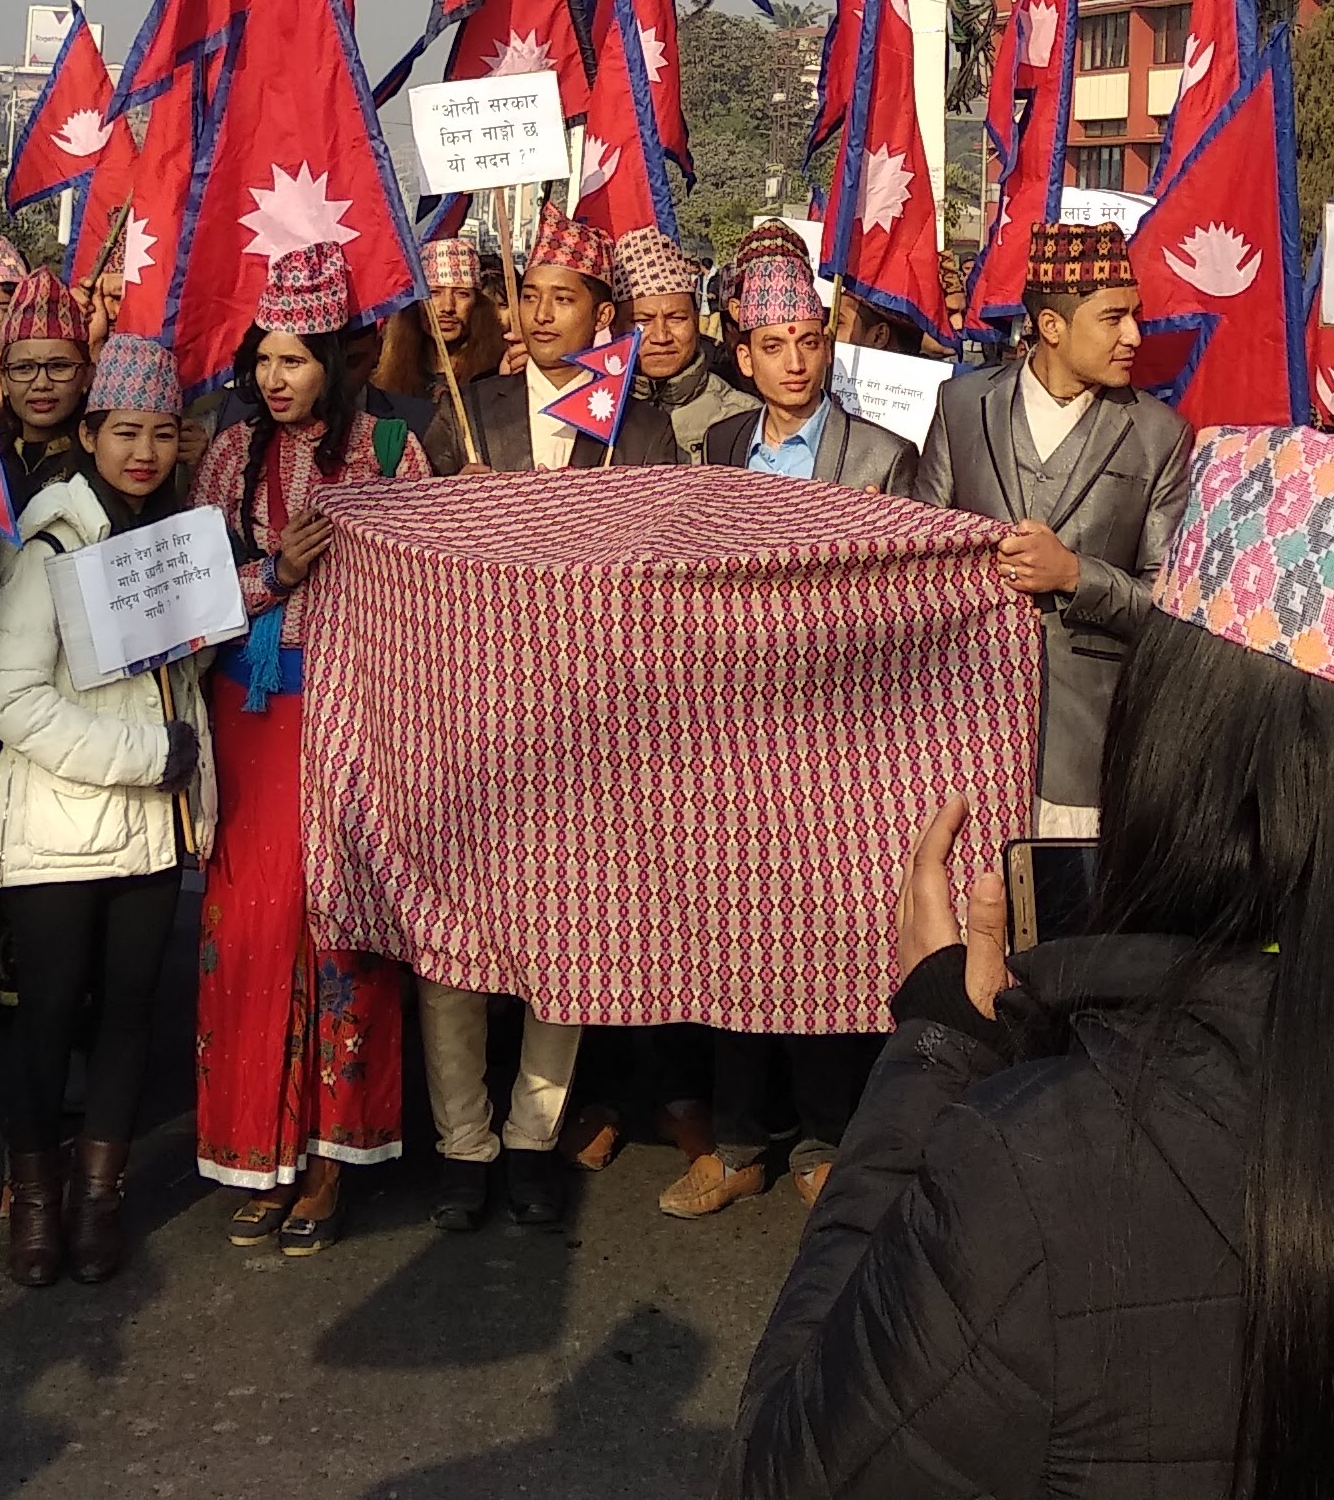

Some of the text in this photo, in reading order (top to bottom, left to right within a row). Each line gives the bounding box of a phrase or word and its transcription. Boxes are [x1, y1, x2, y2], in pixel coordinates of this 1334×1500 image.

[488, 94, 538, 113] सरकार
[440, 127, 472, 147] किन
[523, 121, 539, 138] छ
[447, 153, 465, 172] यो
[474, 152, 510, 169] सदन
[1060, 202, 1126, 220] लाई मेरो
[172, 533, 192, 548] शिर
